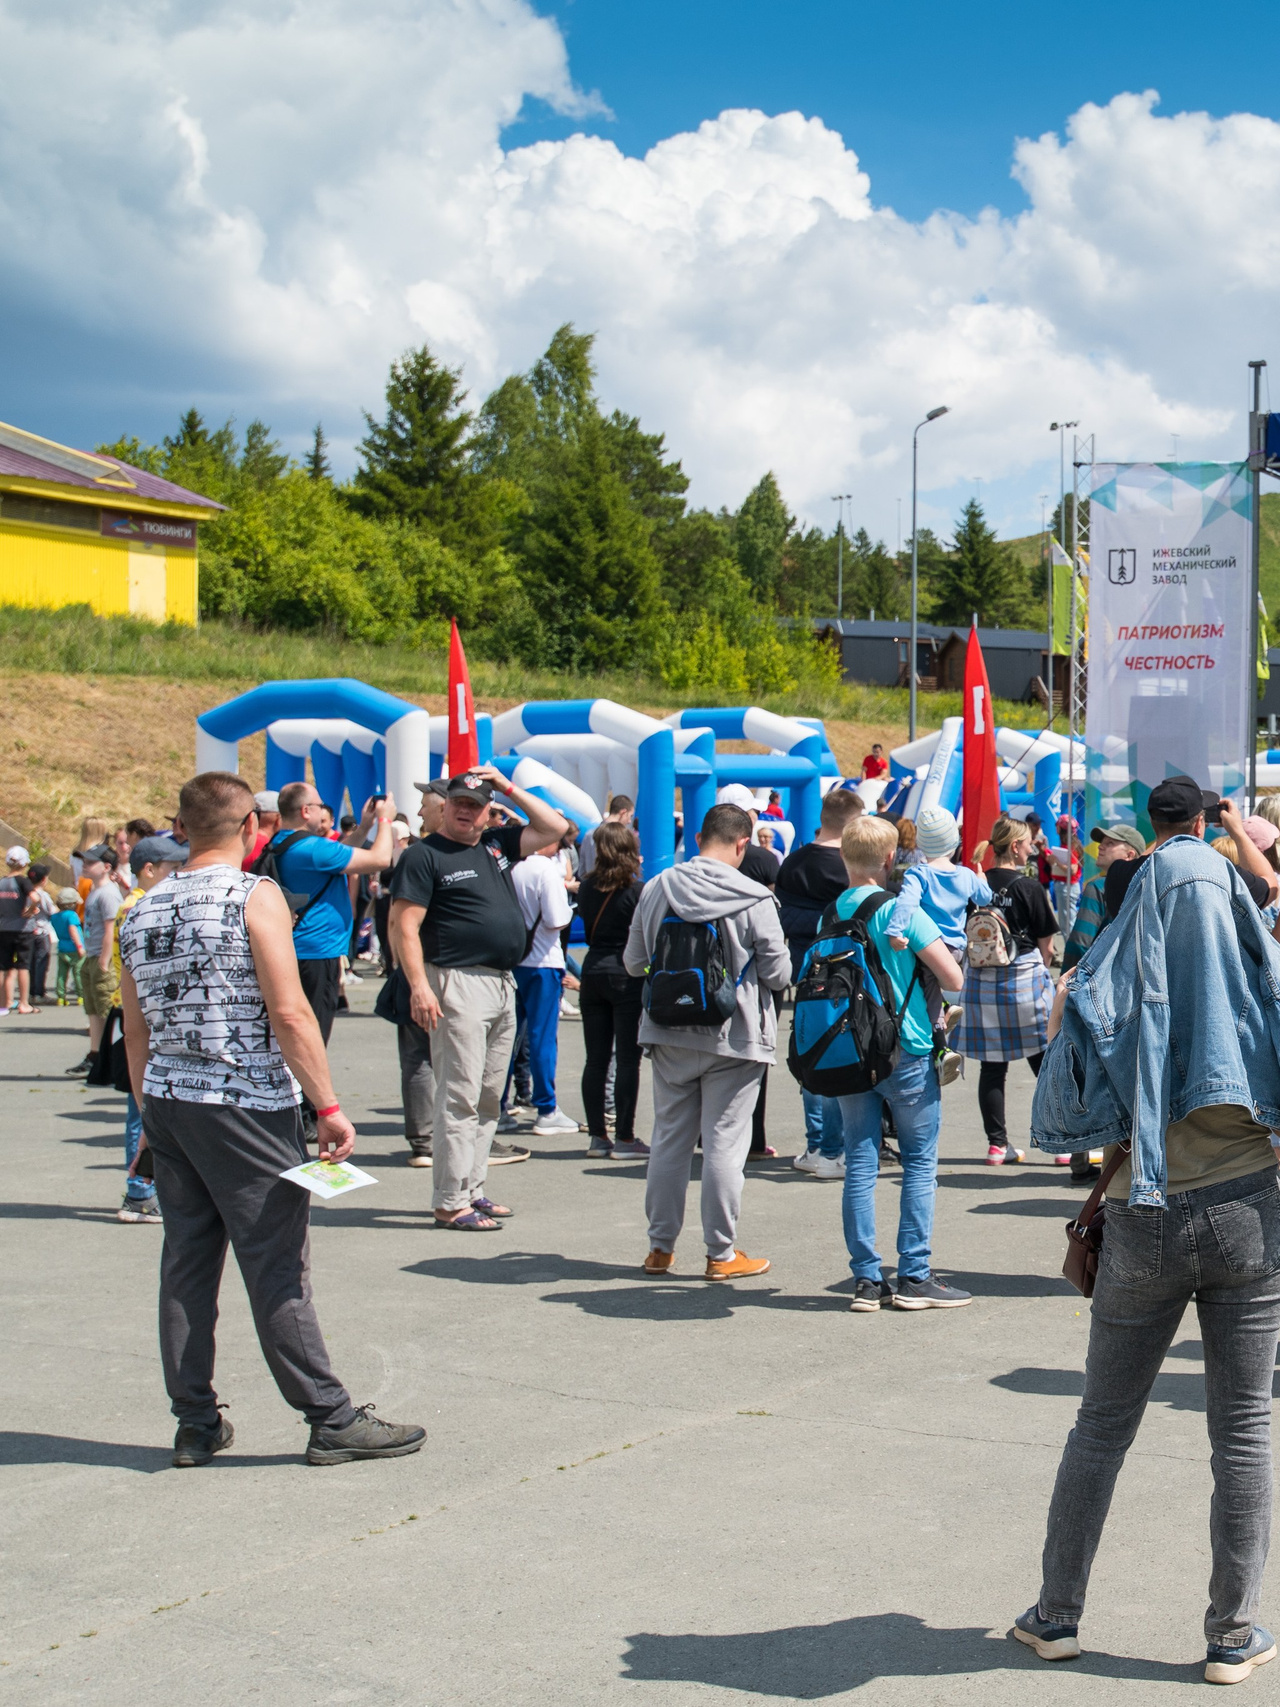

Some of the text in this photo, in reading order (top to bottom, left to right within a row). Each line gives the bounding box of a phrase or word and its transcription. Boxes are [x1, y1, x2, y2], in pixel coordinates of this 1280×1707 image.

[142, 521, 192, 539] ТЮБИНГИ
[1153, 545, 1211, 558] ИЖЕВСКИЙ
[1152, 556, 1237, 571] МЕХАНИЧЕСКИЙ
[1152, 574, 1188, 586] ЗАВОД
[1118, 624, 1225, 641] ПАТРИОТИЗМ
[1124, 654, 1216, 671] ЧЕСТНОСТЬ
